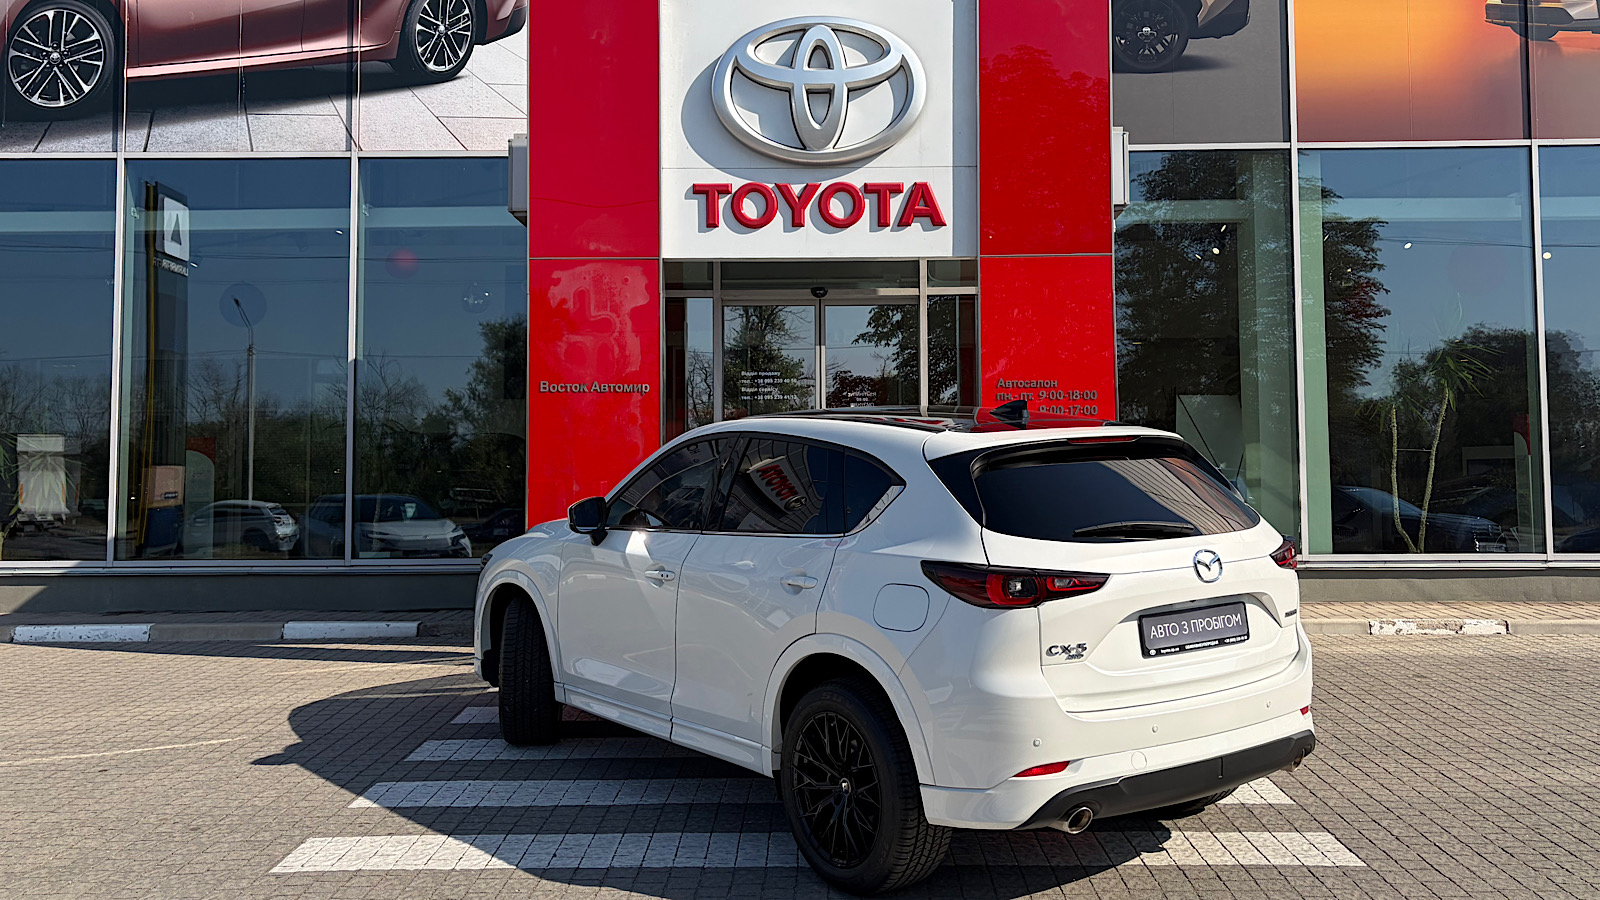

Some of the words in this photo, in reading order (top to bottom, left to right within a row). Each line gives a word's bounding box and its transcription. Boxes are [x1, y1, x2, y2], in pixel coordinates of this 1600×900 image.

[693, 181, 947, 229] TOYOTA
[540, 381, 589, 393] Восток
[590, 381, 650, 396] Автомир
[997, 378, 1058, 388] Автосалон
[1039, 390, 1098, 400] 9:00-18:00
[1150, 622, 1180, 639] АВТО
[1190, 612, 1242, 633] ПРОБІГОМ
[1045, 643, 1087, 657] CX-5
